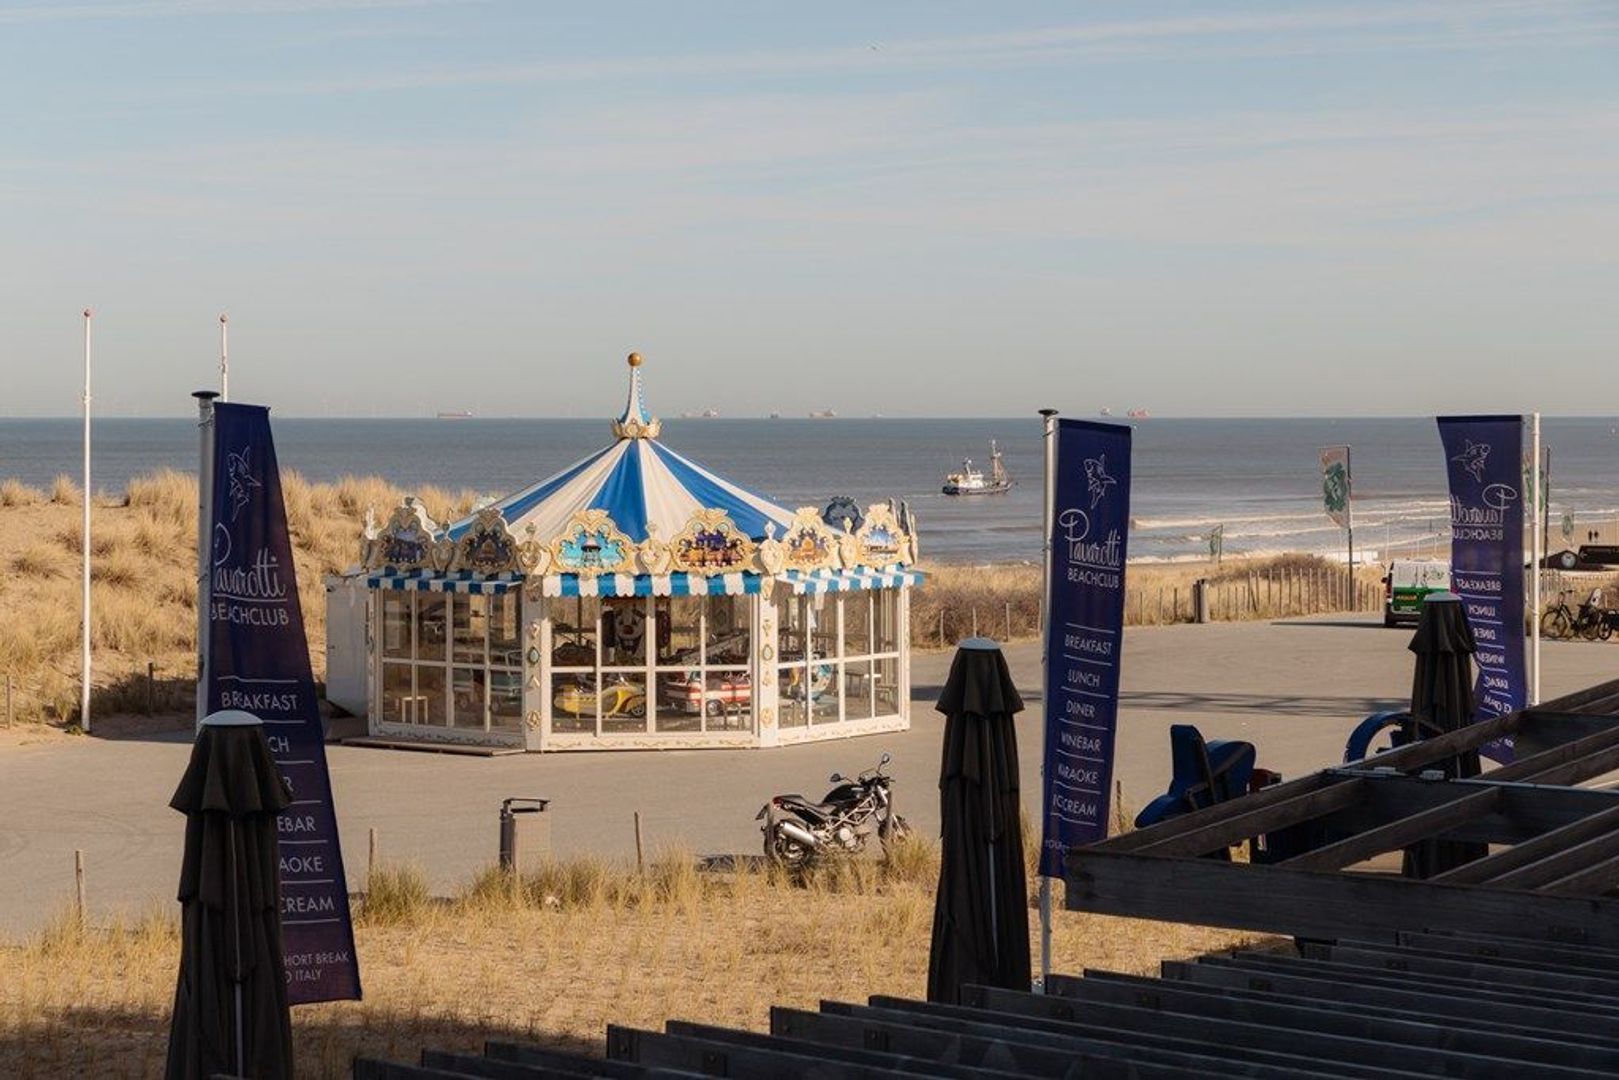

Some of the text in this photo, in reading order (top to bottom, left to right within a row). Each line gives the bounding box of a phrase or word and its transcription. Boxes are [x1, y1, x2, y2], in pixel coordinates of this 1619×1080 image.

[1059, 508, 1121, 566] Pavarotti
[1067, 567, 1120, 589] BEACHCLUB
[1064, 633, 1112, 655] BREAKFAST
[1068, 668, 1100, 687] LUNCH
[277, 815, 316, 832] EBAR
[279, 856, 323, 873] AOKE
[283, 951, 349, 967] HORT BREAK
[295, 969, 322, 981] ITALY
